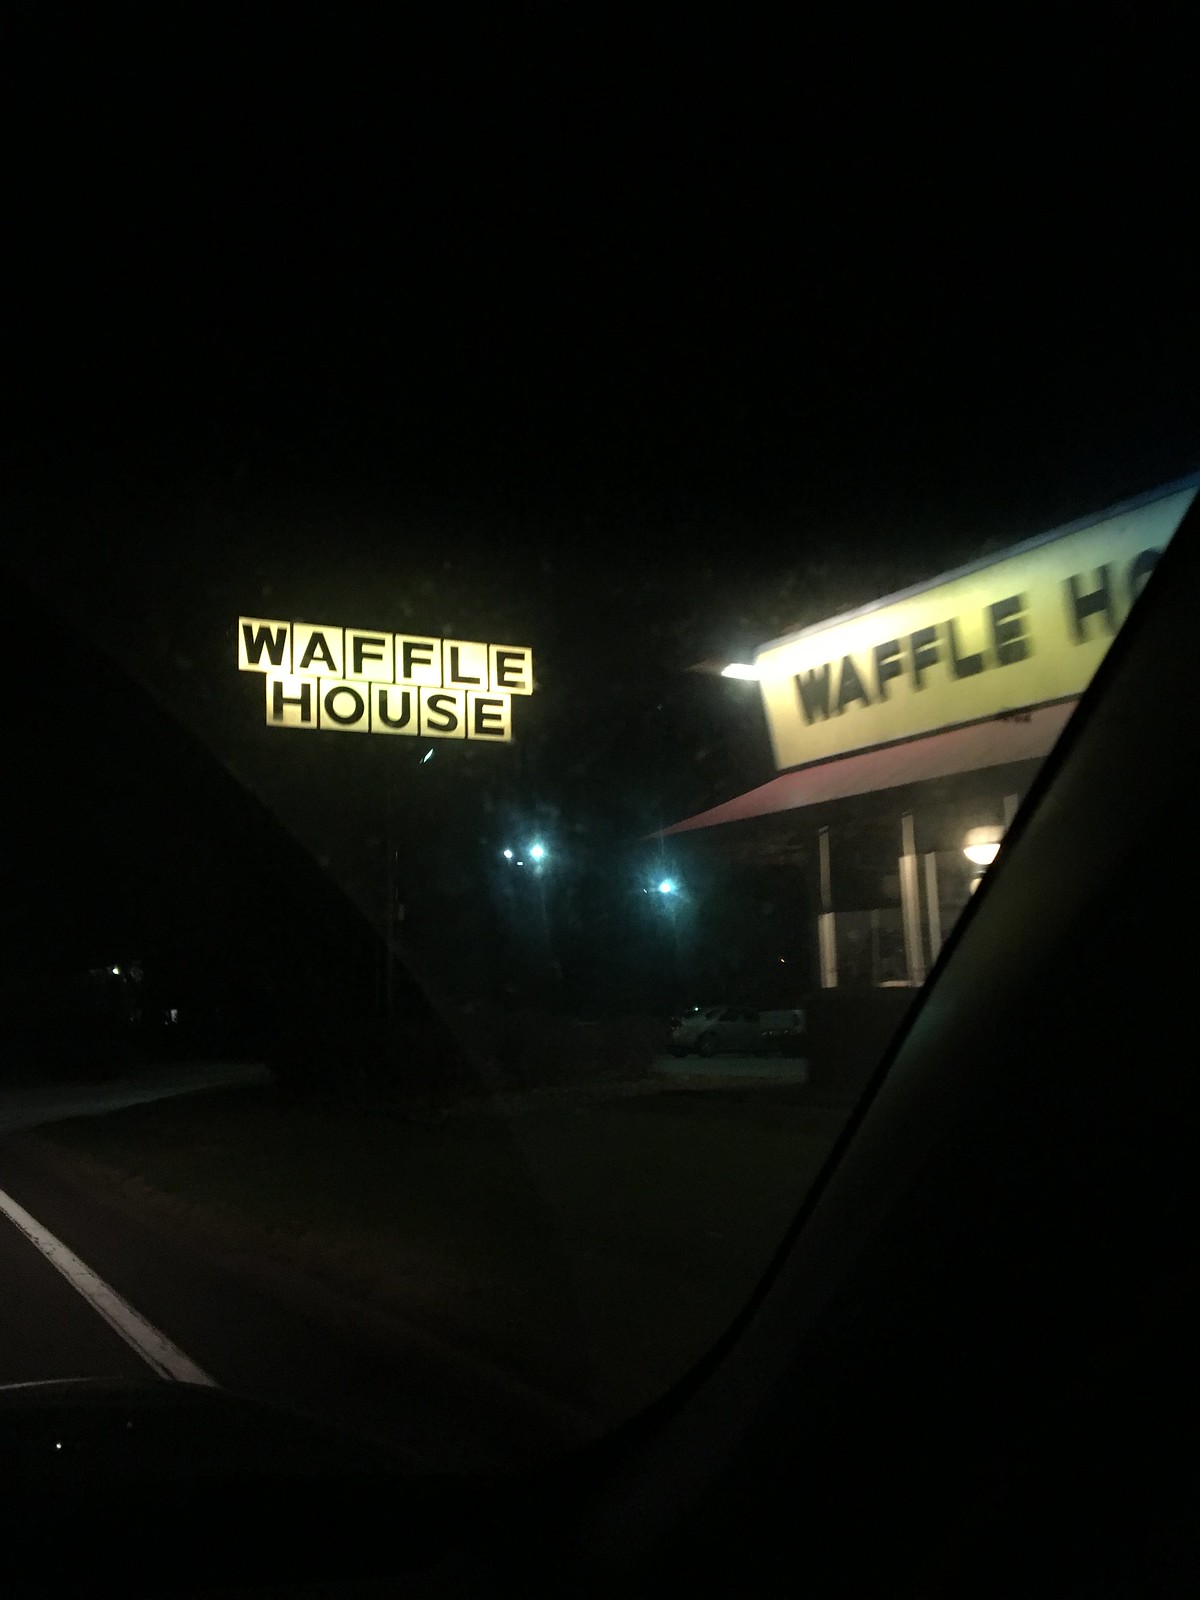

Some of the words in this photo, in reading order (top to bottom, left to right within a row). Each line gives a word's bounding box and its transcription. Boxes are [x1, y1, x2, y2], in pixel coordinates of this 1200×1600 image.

[242, 624, 525, 689] WAFFLE
[794, 592, 1033, 727] WAFFLE
[272, 681, 505, 735] HOUSE
